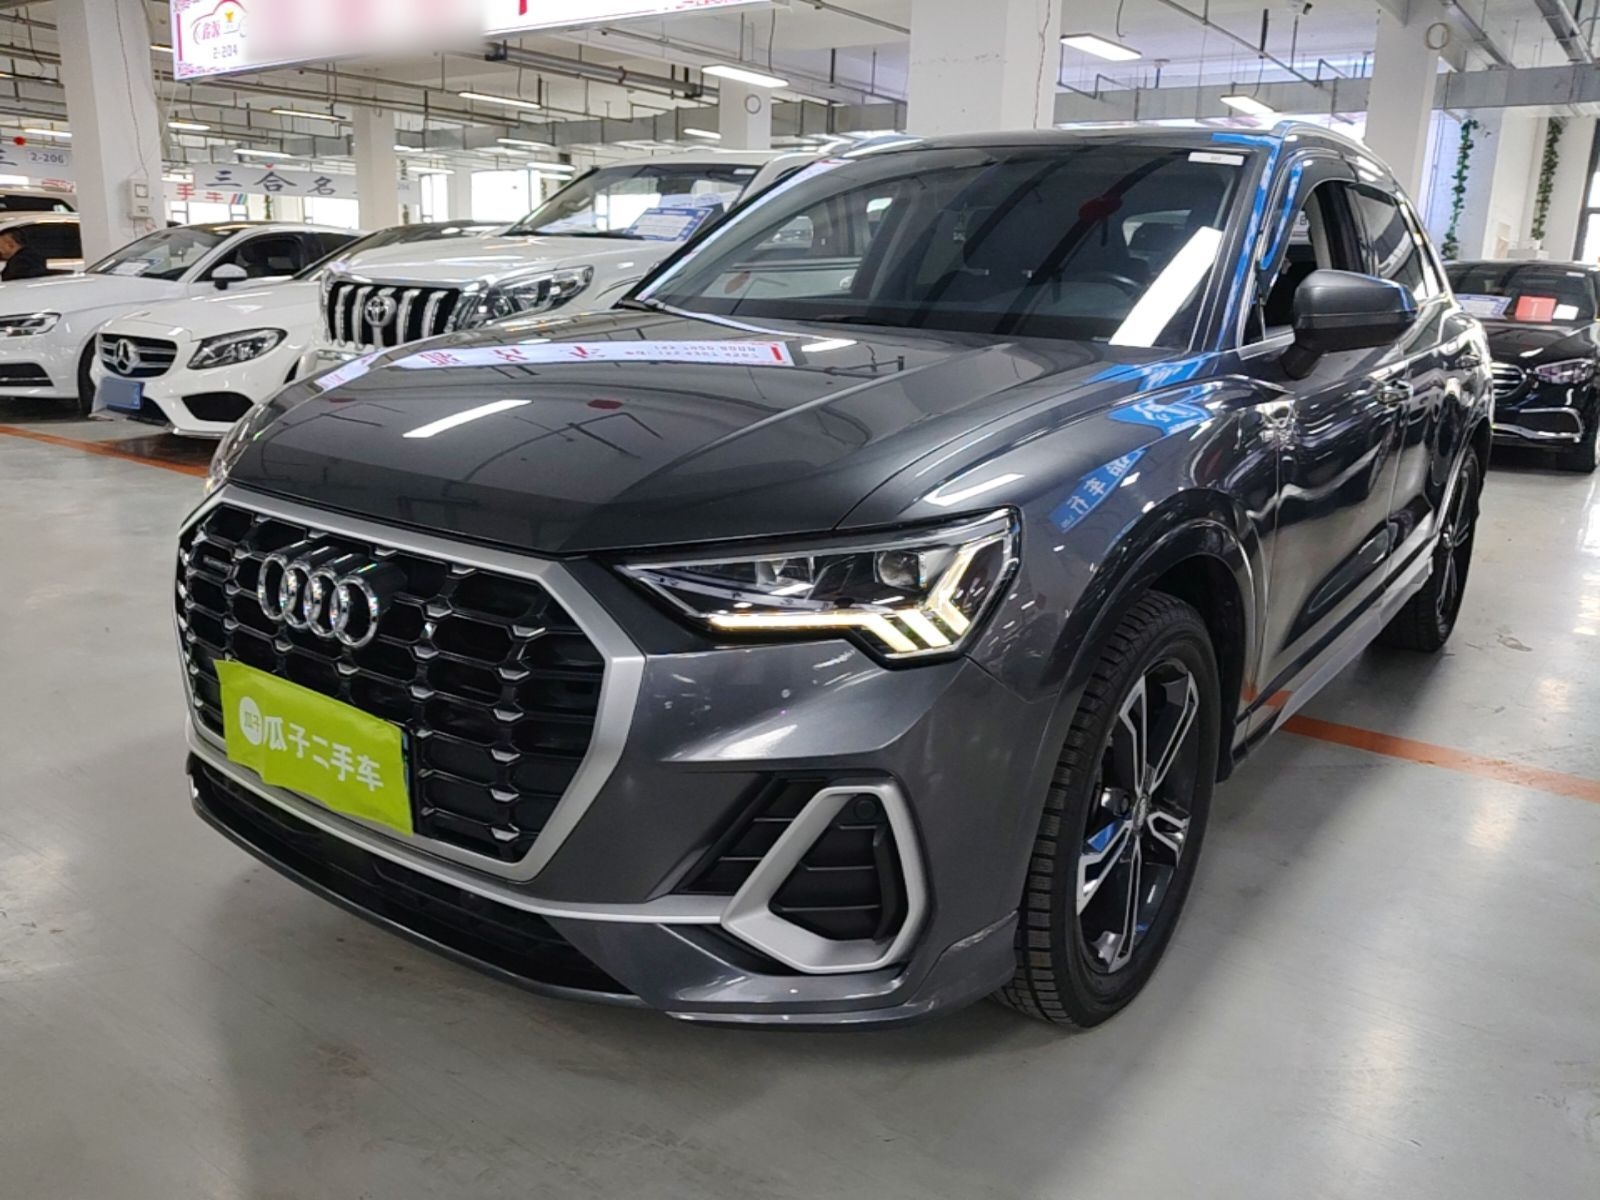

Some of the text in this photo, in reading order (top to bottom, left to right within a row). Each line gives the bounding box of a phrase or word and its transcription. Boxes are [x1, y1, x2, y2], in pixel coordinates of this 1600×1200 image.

[31, 152, 65, 164] 2-206
[205, 170, 336, 196] 三合名
[263, 716, 384, 792] 瓜子二手车
